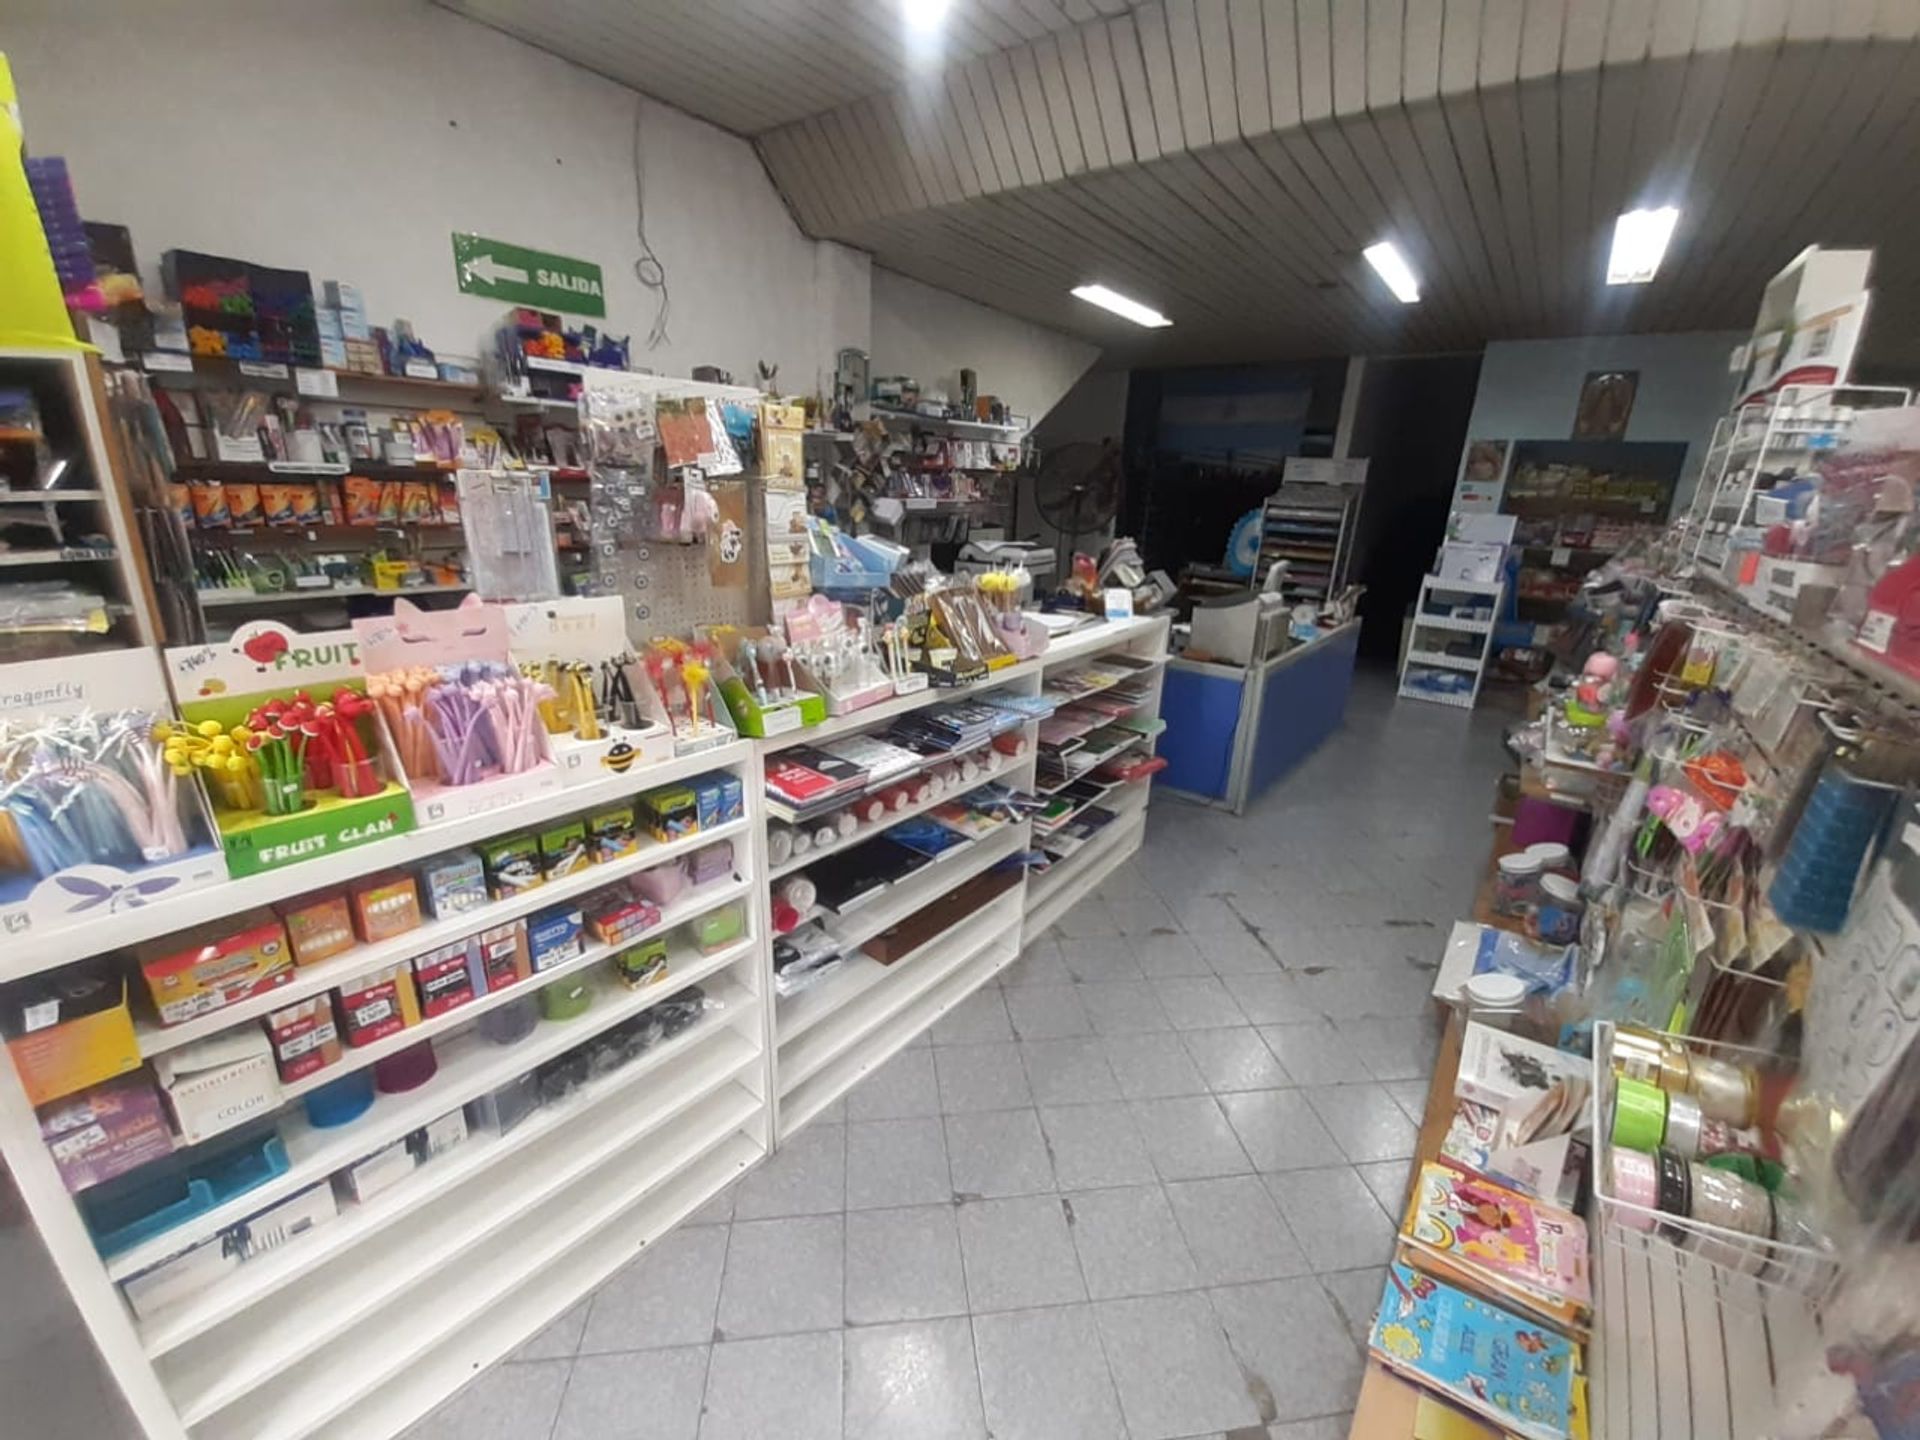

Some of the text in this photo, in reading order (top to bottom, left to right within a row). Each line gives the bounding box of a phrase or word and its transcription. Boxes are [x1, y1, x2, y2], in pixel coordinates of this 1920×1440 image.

[537, 270, 601, 296] SALIDA
[274, 643, 358, 671] FRUIT
[0, 682, 84, 706] ragonfly
[258, 818, 394, 863] FRUIT CLAN
